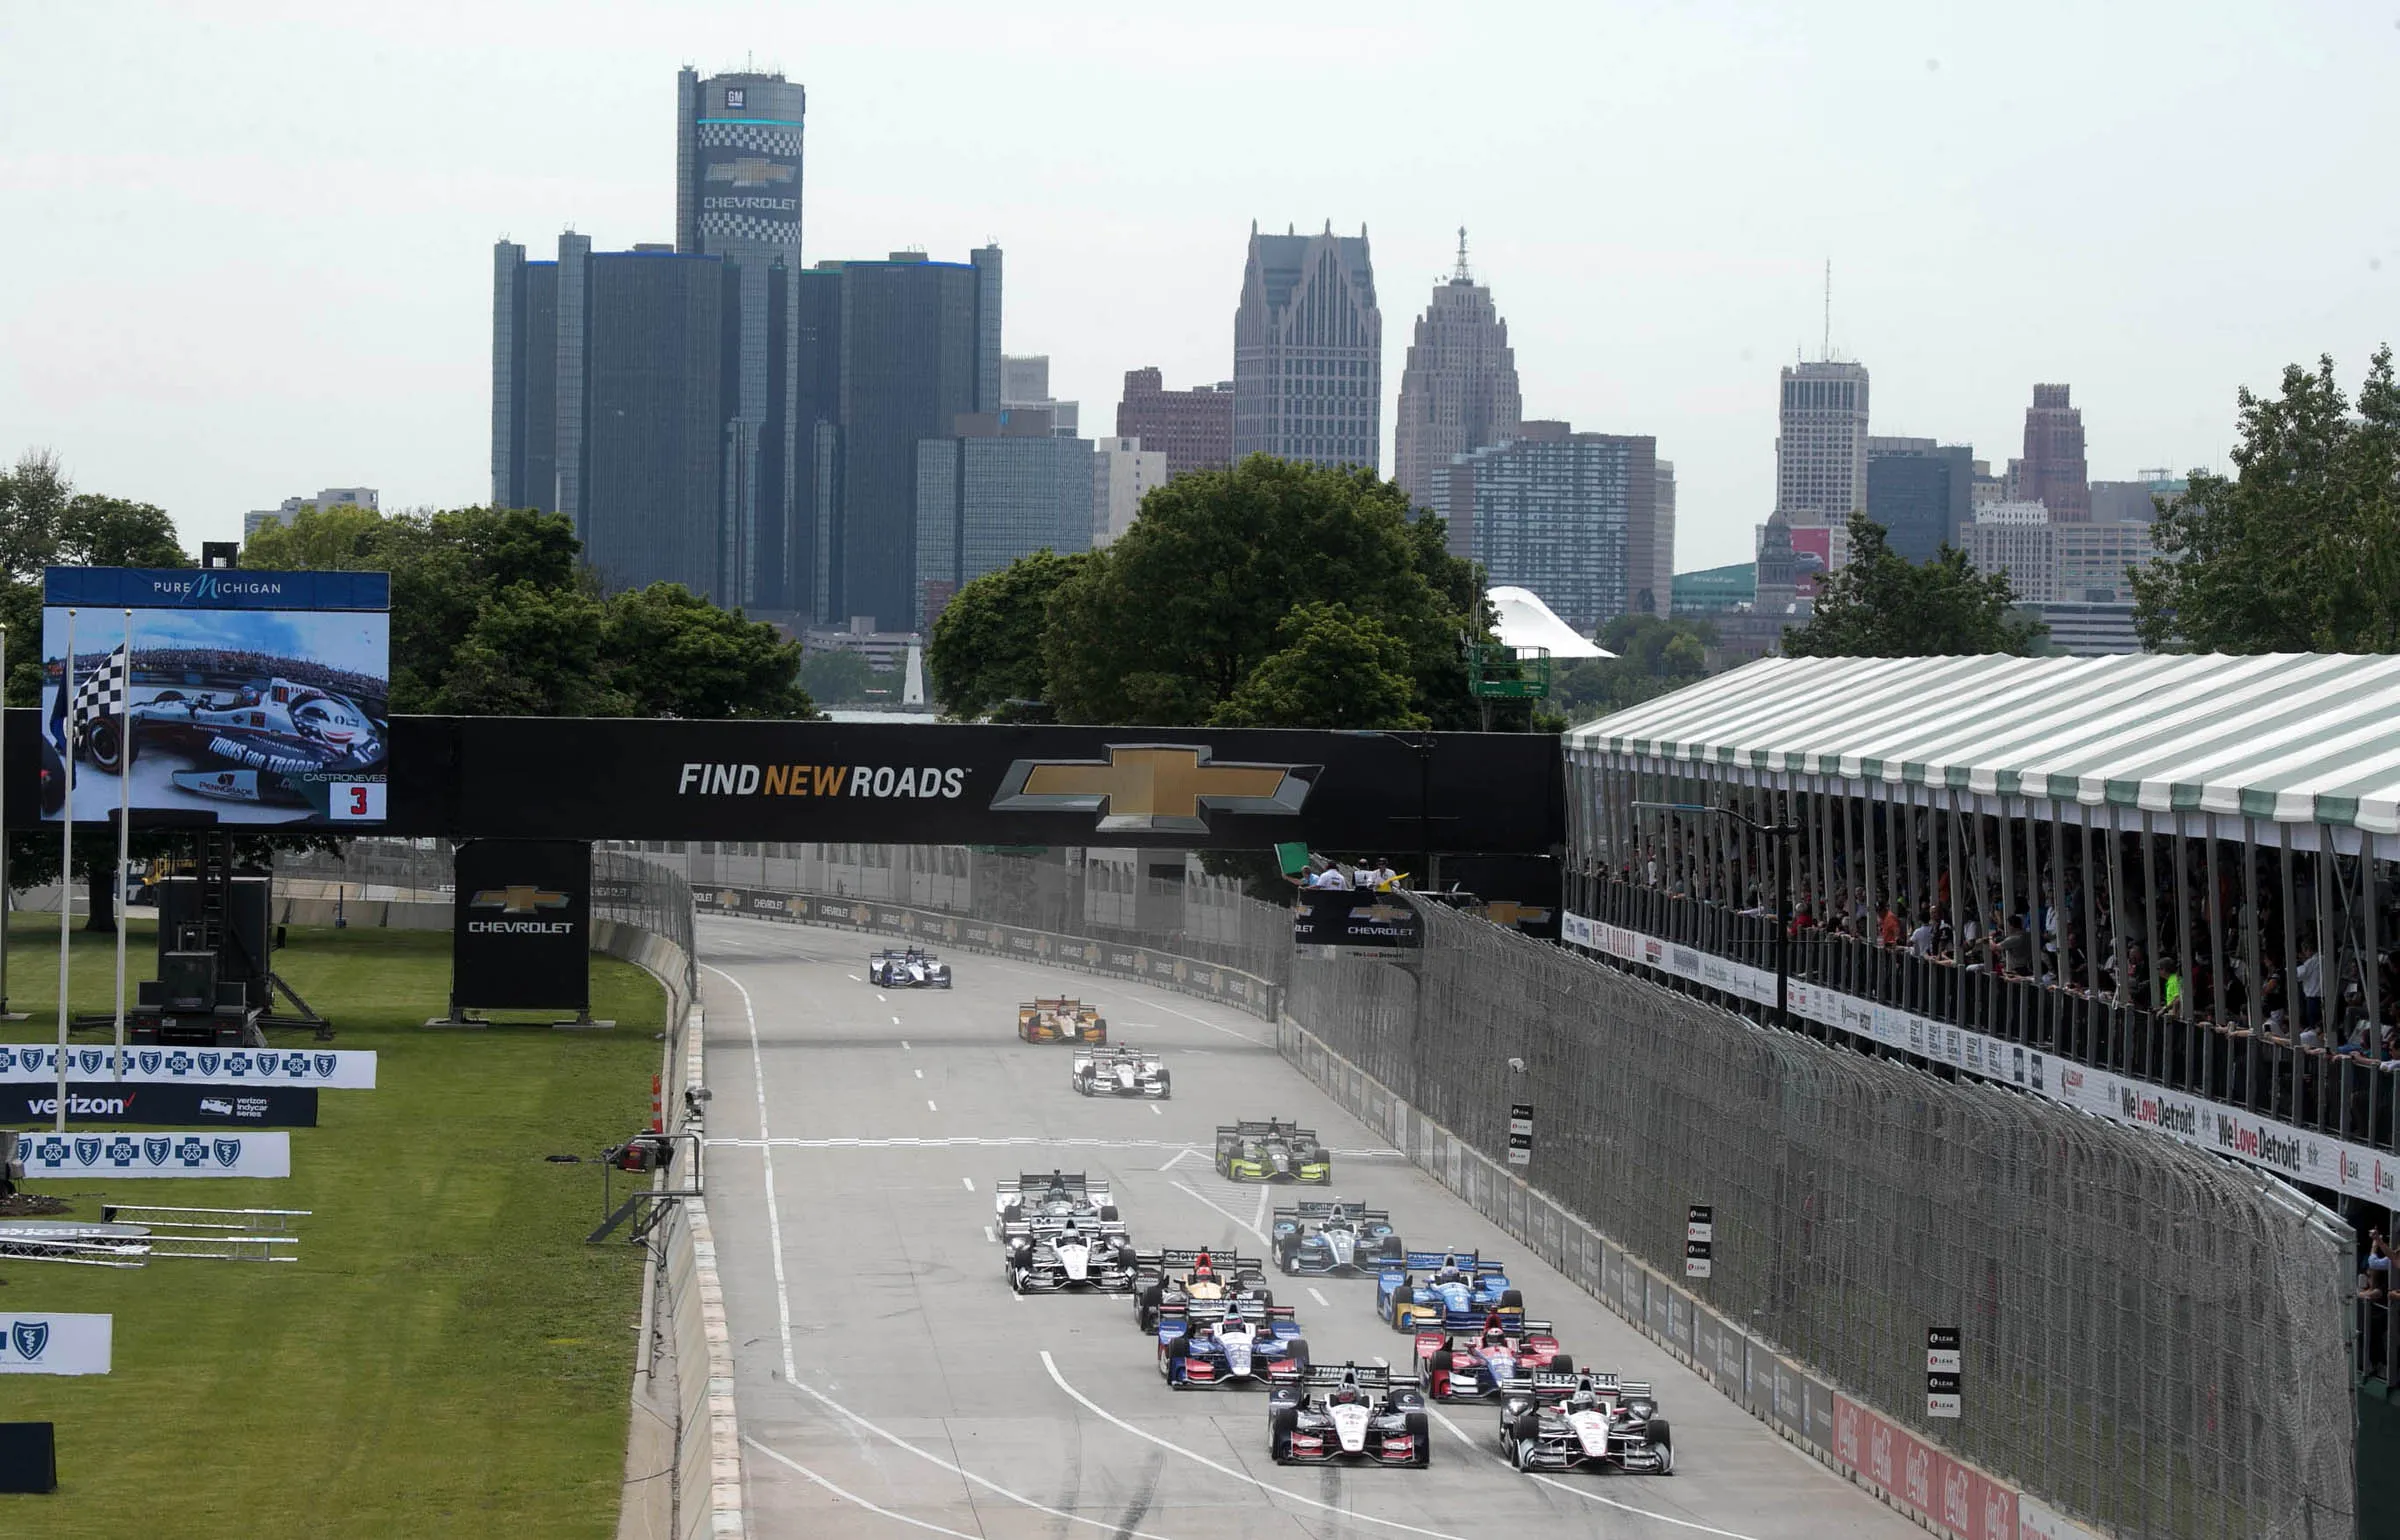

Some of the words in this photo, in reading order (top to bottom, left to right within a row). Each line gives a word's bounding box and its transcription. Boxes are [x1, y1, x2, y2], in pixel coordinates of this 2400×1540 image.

[728, 91, 743, 102] GM
[704, 197, 796, 210] CHEVROLET
[154, 582, 191, 593] PURE
[180, 573, 281, 604] MICHIGAN
[303, 773, 387, 783] CASTRONEVES
[678, 763, 760, 795] FIND
[764, 765, 847, 797] NEW
[849, 766, 964, 799] ROADS
[351, 787, 367, 815] 3
[468, 921, 574, 935] CHEVROLET
[1348, 926, 1414, 936] CHEVROLET
[2121, 1086, 2136, 1118] We
[2136, 1090, 2157, 1125] Love
[2158, 1096, 2195, 1136] Detroit!
[2217, 1113, 2233, 1148] We
[2234, 1118, 2257, 1157] Love
[2259, 1126, 2300, 1172] Detroit!
